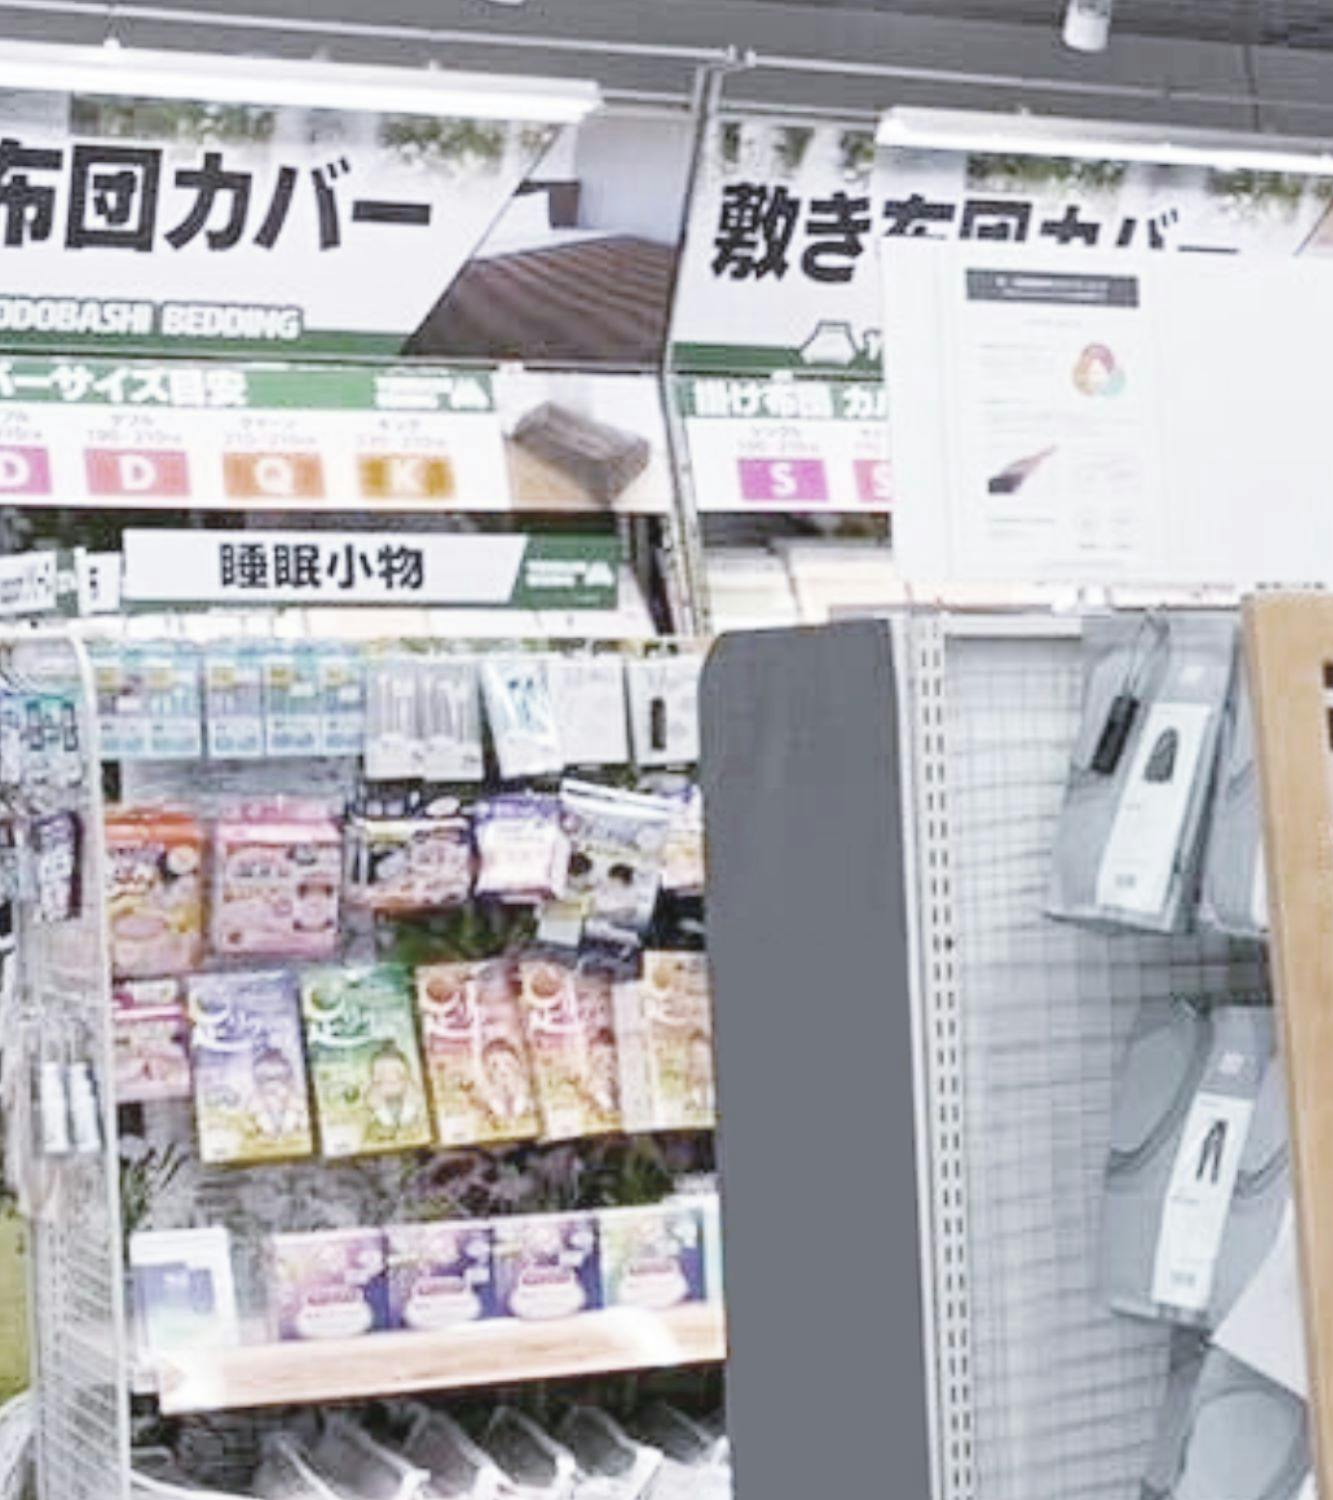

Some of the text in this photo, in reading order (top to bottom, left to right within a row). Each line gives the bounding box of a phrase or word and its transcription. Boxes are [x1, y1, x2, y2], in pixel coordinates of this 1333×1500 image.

[0, 138, 431, 252] 布団カバー
[161, 302, 301, 339] BEDDING
[0, 362, 248, 407] ーサイズ目安
[119, 455, 157, 492] D
[770, 460, 797, 498] S
[219, 542, 426, 592] 睡眠小物
